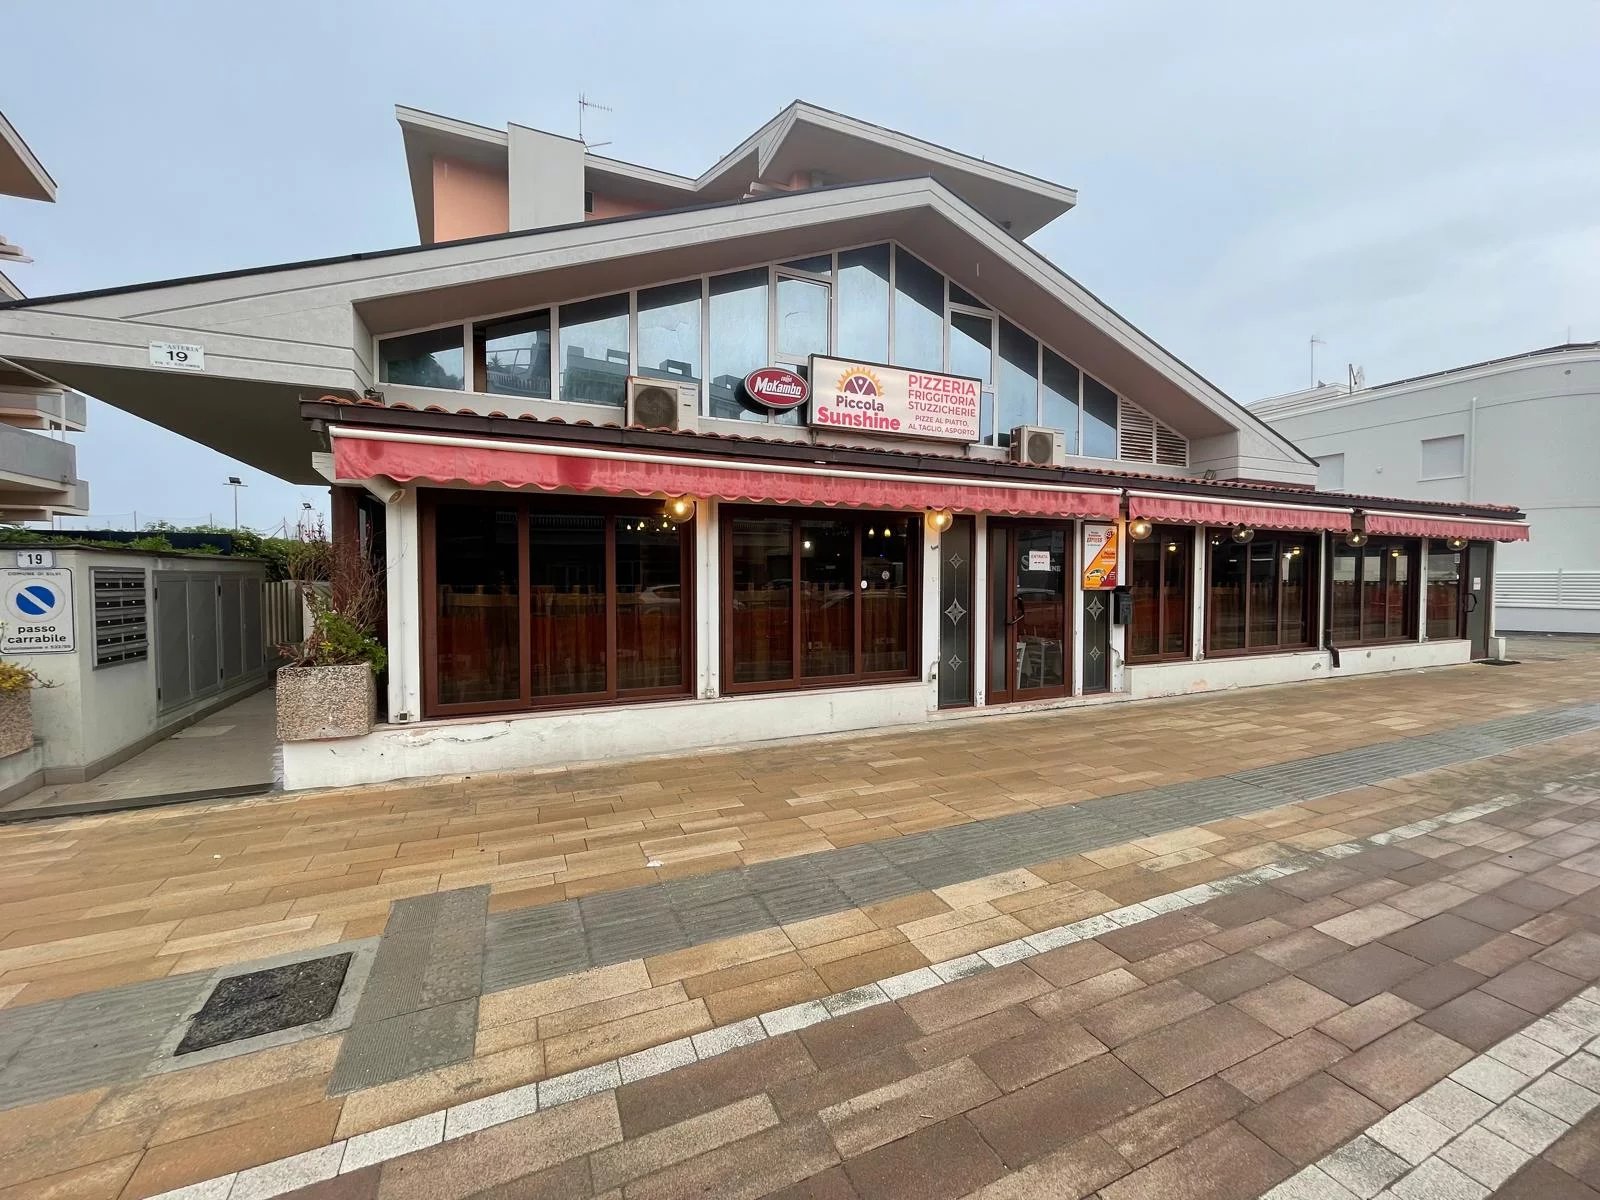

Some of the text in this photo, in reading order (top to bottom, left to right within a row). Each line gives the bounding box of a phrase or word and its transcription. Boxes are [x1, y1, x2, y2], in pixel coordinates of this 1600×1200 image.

[166, 350, 188, 362] 19
[908, 374, 976, 396] PIZZERIA
[836, 395, 885, 413] Piccola
[908, 389, 976, 407] FRIGGITORIA
[908, 400, 976, 418] STUZZICHERIE
[817, 406, 901, 431] Sunshine
[915, 415, 934, 423] PIZZE
[944, 418, 970, 427] PIATTO,
[918, 424, 944, 434] TAGLIO,
[944, 427, 975, 436] ASPORTO
[27, 553, 43, 565] 19
[17, 625, 56, 634] passo
[7, 634, 67, 644] carrabile
